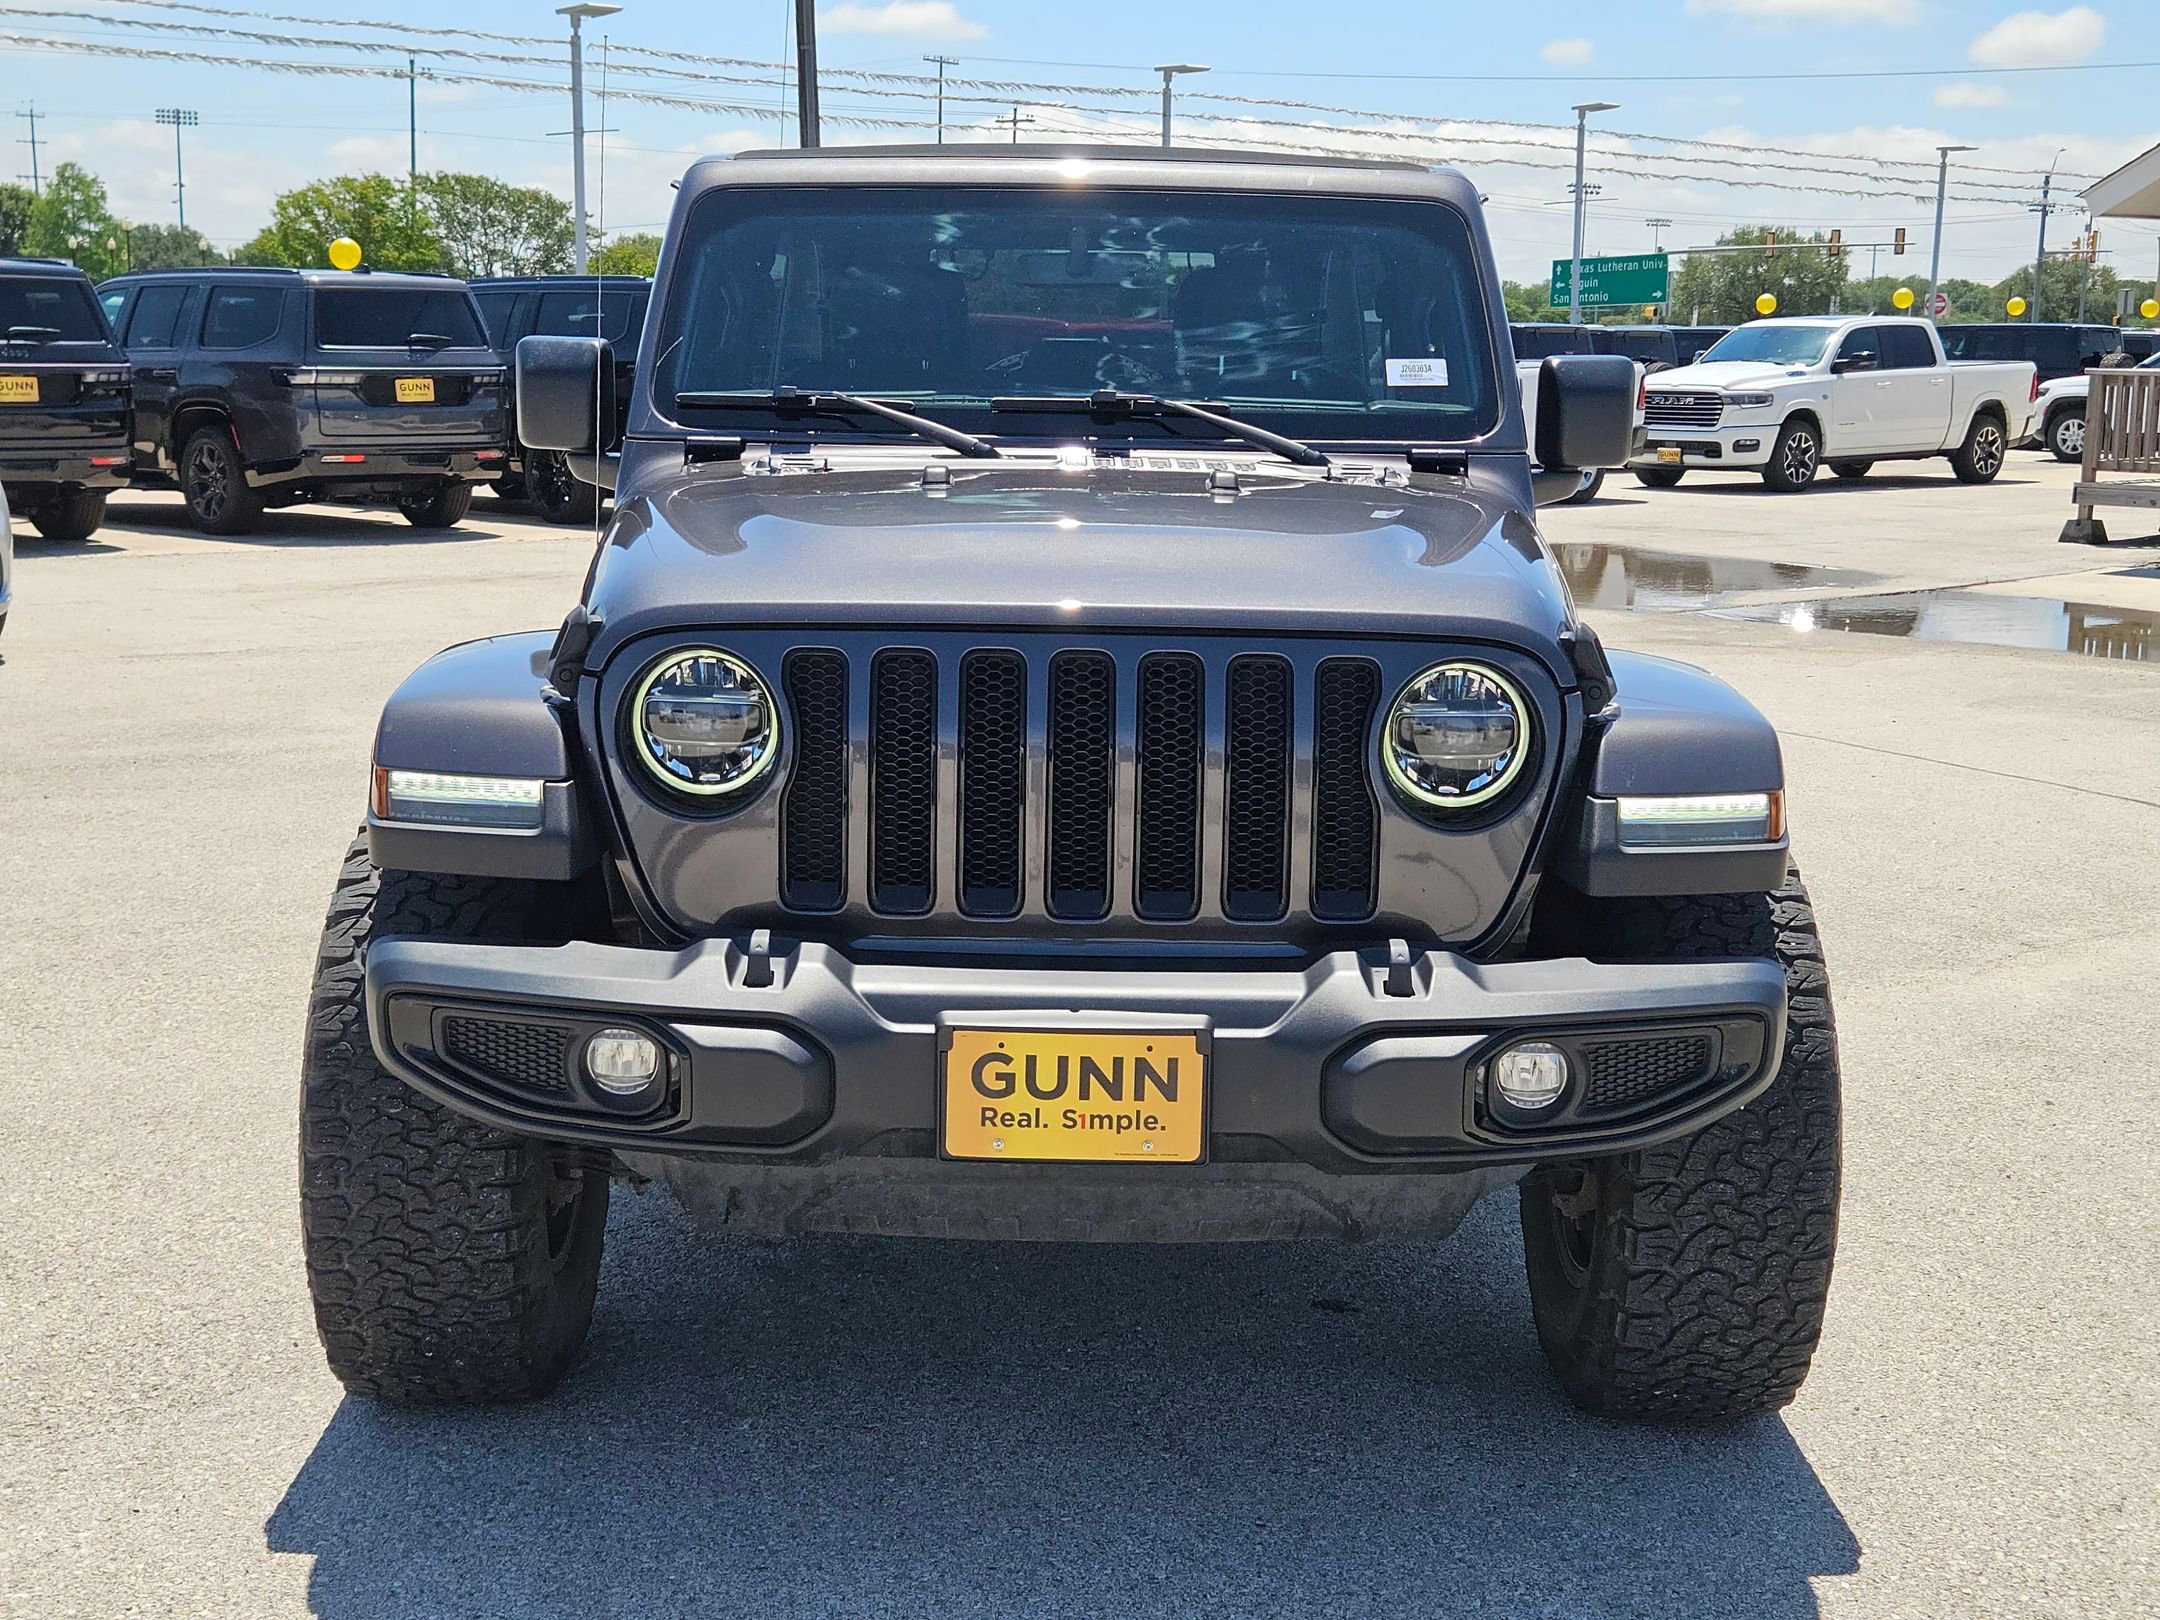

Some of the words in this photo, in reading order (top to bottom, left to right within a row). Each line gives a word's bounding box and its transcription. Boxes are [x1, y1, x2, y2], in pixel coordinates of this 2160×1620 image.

[1569, 264, 1594, 275] Txas
[1598, 261, 1639, 273] Lutheran
[1642, 258, 1663, 269] Univ
[1568, 277, 1598, 291] Sguin
[1553, 294, 1570, 304] San
[1578, 290, 1609, 302] ntonio
[399, 383, 430, 392] GUNN
[1651, 396, 1695, 405] RAM
[971, 1051, 1179, 1103] GUNN
[980, 1107, 1049, 1128] Real.
